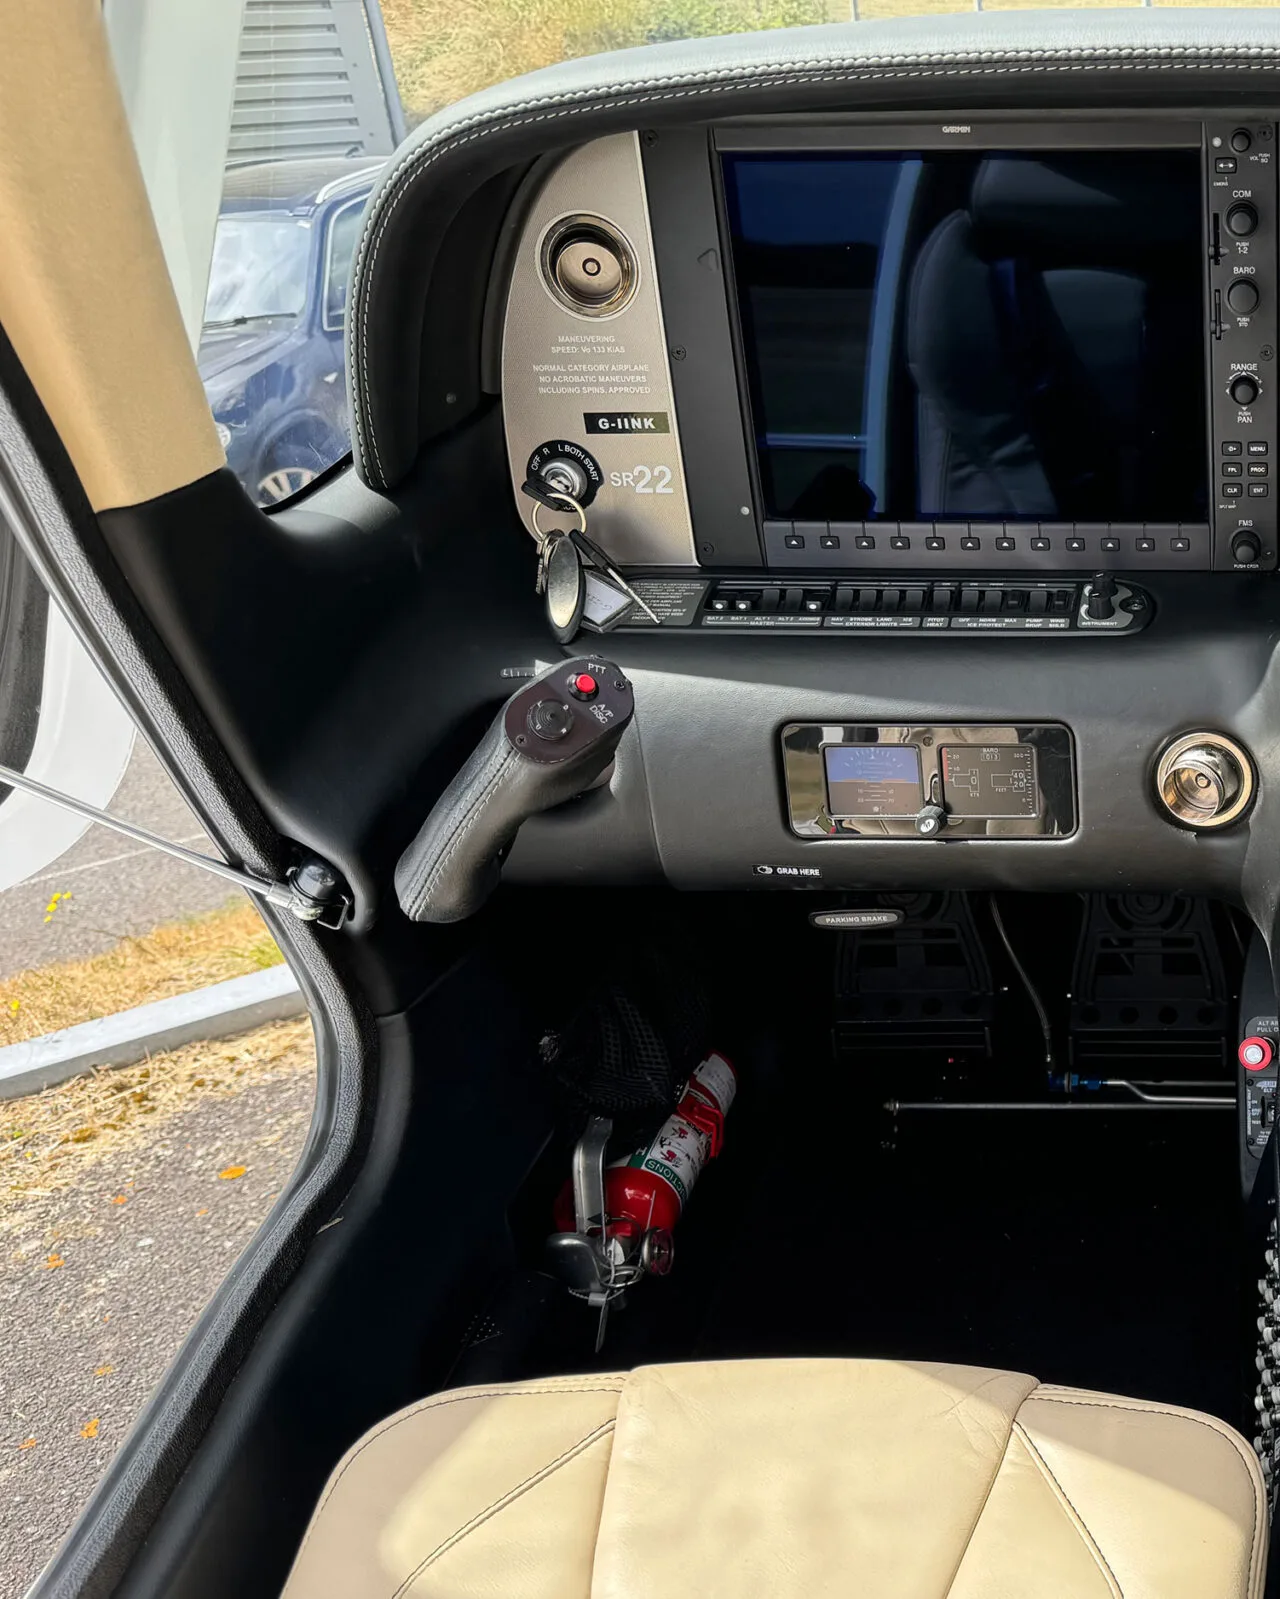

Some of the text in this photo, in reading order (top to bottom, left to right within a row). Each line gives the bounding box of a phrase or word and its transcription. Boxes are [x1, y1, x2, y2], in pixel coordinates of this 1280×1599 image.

[1232, 190, 1252, 198] COM
[1233, 266, 1256, 275] BARO
[558, 335, 616, 343] MANEUVERING
[551, 346, 580, 354] SPEED:
[533, 364, 649, 372] NORMAL CATEGORY AIRPLANE
[1230, 363, 1258, 371] RANGE
[539, 386, 580, 394] INCLUDING
[608, 386, 651, 394] APPROVED
[598, 417, 657, 430] G-IINK
[1237, 416, 1253, 424] PAN
[564, 444, 585, 461] BOTH
[583, 458, 599, 482] START
[610, 465, 674, 494] SR22
[588, 663, 607, 674] PTT
[589, 704, 608, 724] DISC
[597, 703, 614, 718] A/P
[776, 867, 820, 876] GRAB HERE
[825, 916, 860, 924] PARKING
